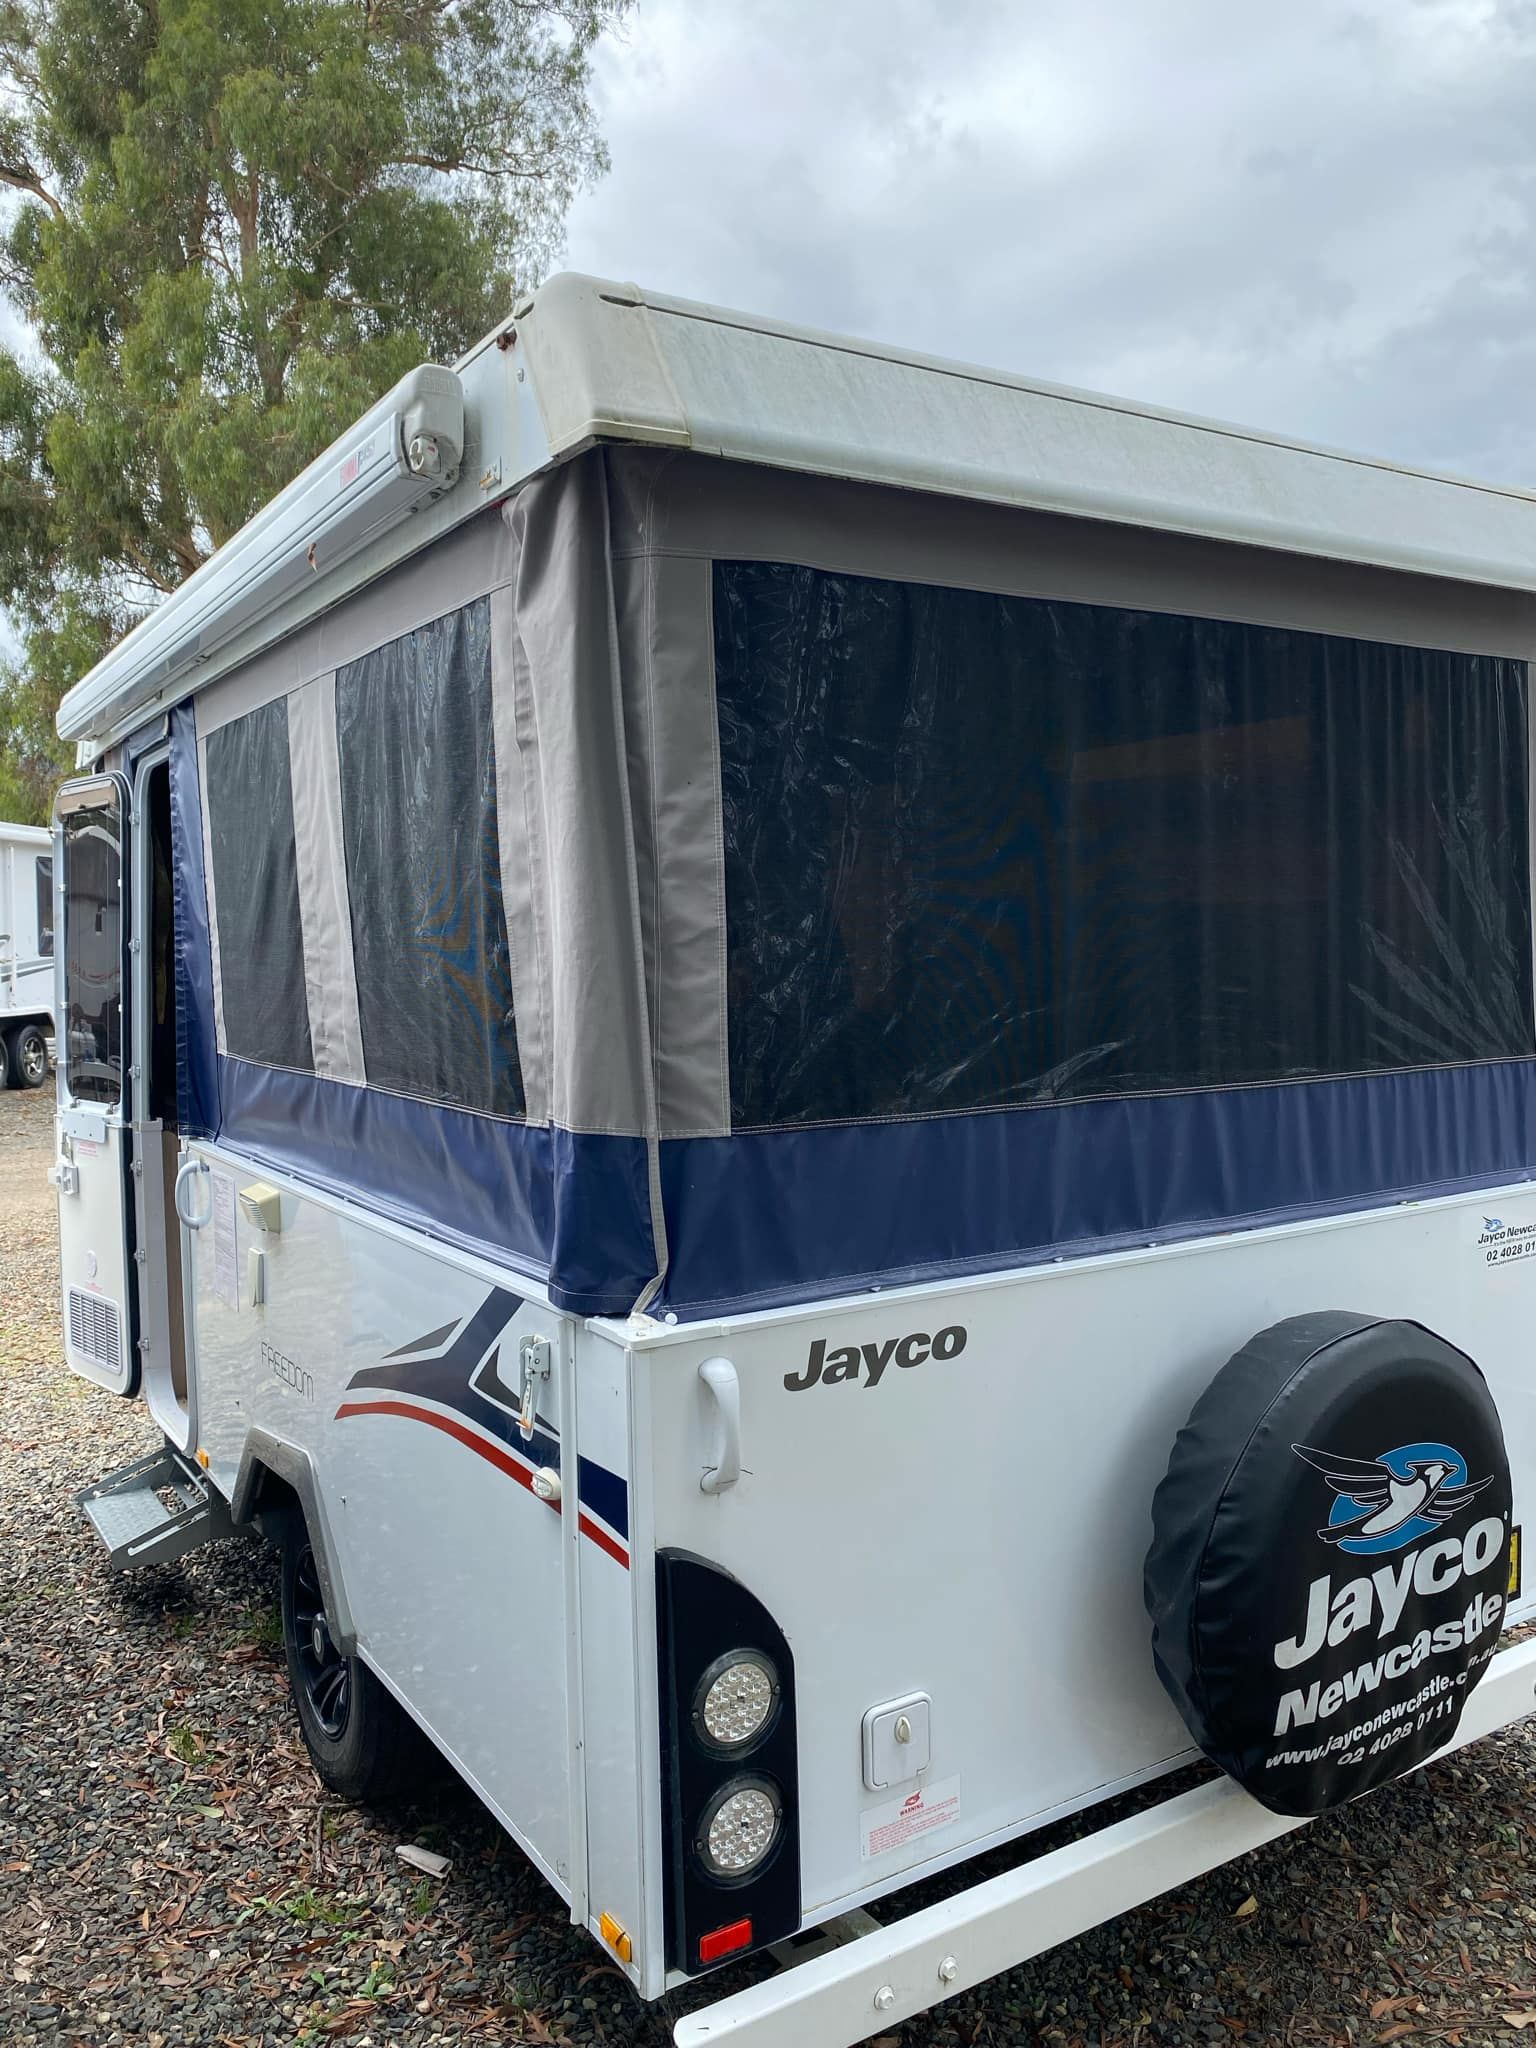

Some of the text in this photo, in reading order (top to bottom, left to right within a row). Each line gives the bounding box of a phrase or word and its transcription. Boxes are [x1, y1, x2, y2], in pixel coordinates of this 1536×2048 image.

[1477, 1231, 1506, 1244] Jayco
[1486, 1249, 1498, 1262] 02
[1499, 1244, 1522, 1257] 4028
[783, 1325, 968, 1392] Jayco
[1273, 1516, 1505, 1670] Jayco
[1273, 1592, 1502, 1737] Newcastle
[1265, 1642, 1498, 1769] www.jayconewcastle.cm.au
[1337, 1695, 1454, 1766] 02 4028 0111
